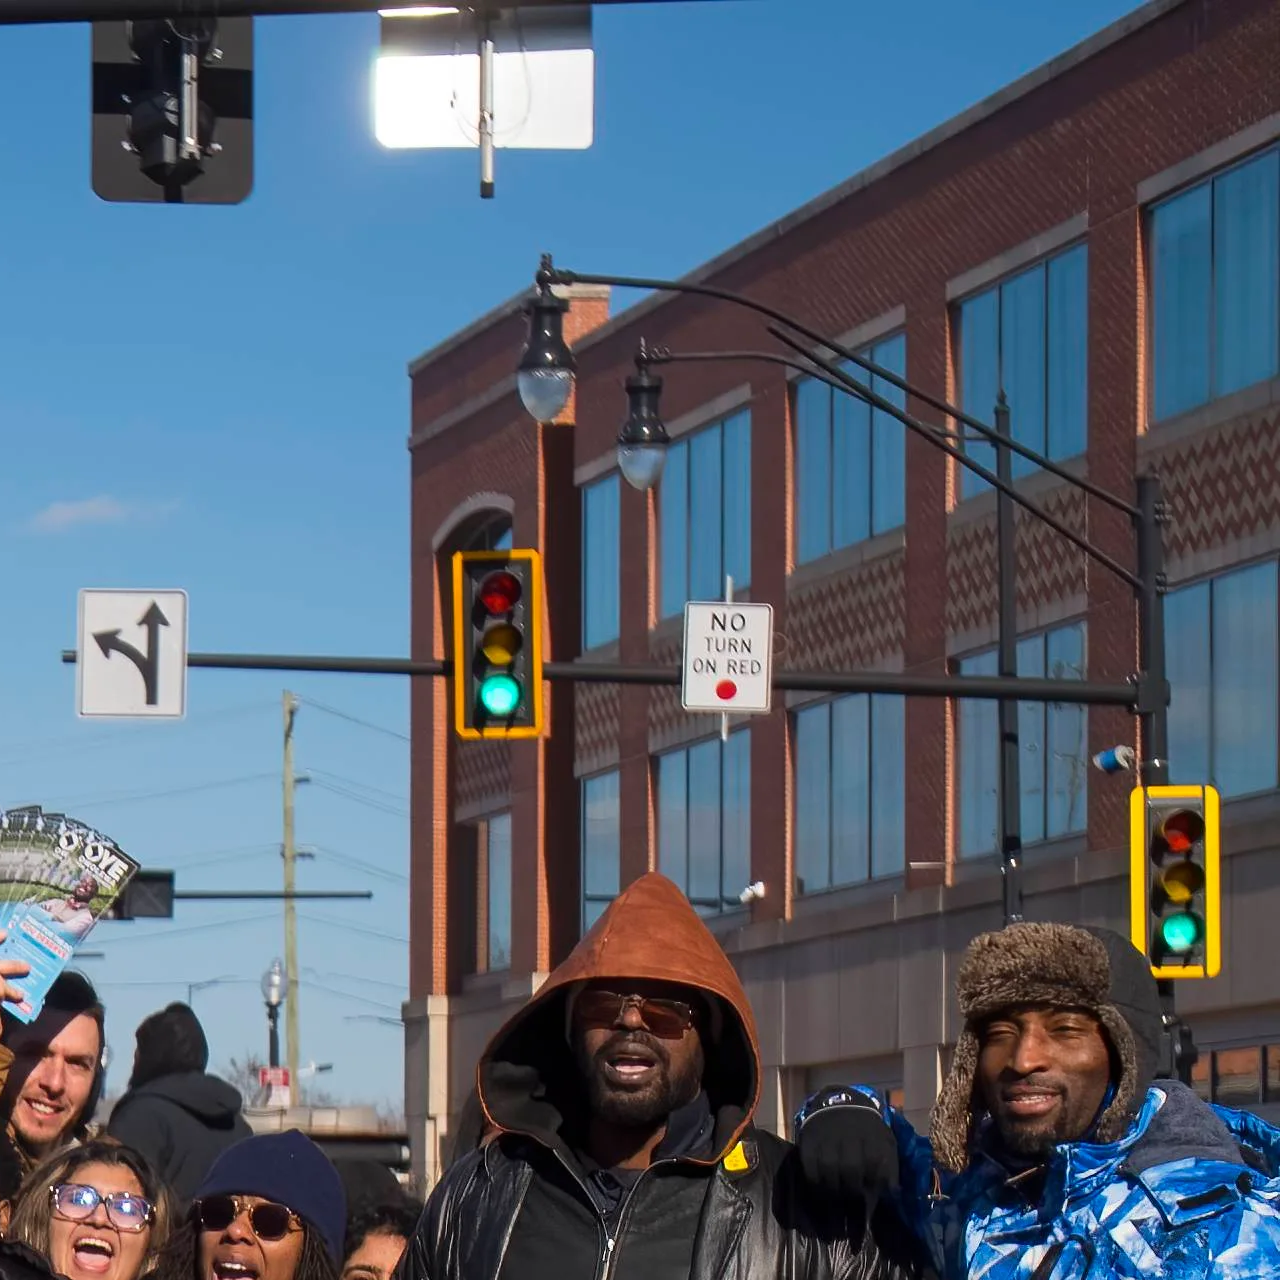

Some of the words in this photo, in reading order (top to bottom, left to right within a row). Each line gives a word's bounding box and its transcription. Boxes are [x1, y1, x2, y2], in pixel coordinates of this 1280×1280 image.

[711, 612, 746, 632] NO
[704, 637, 752, 654] TURN
[693, 657, 717, 675] ON
[727, 659, 762, 676] RED
[85, 841, 129, 883] OYE
